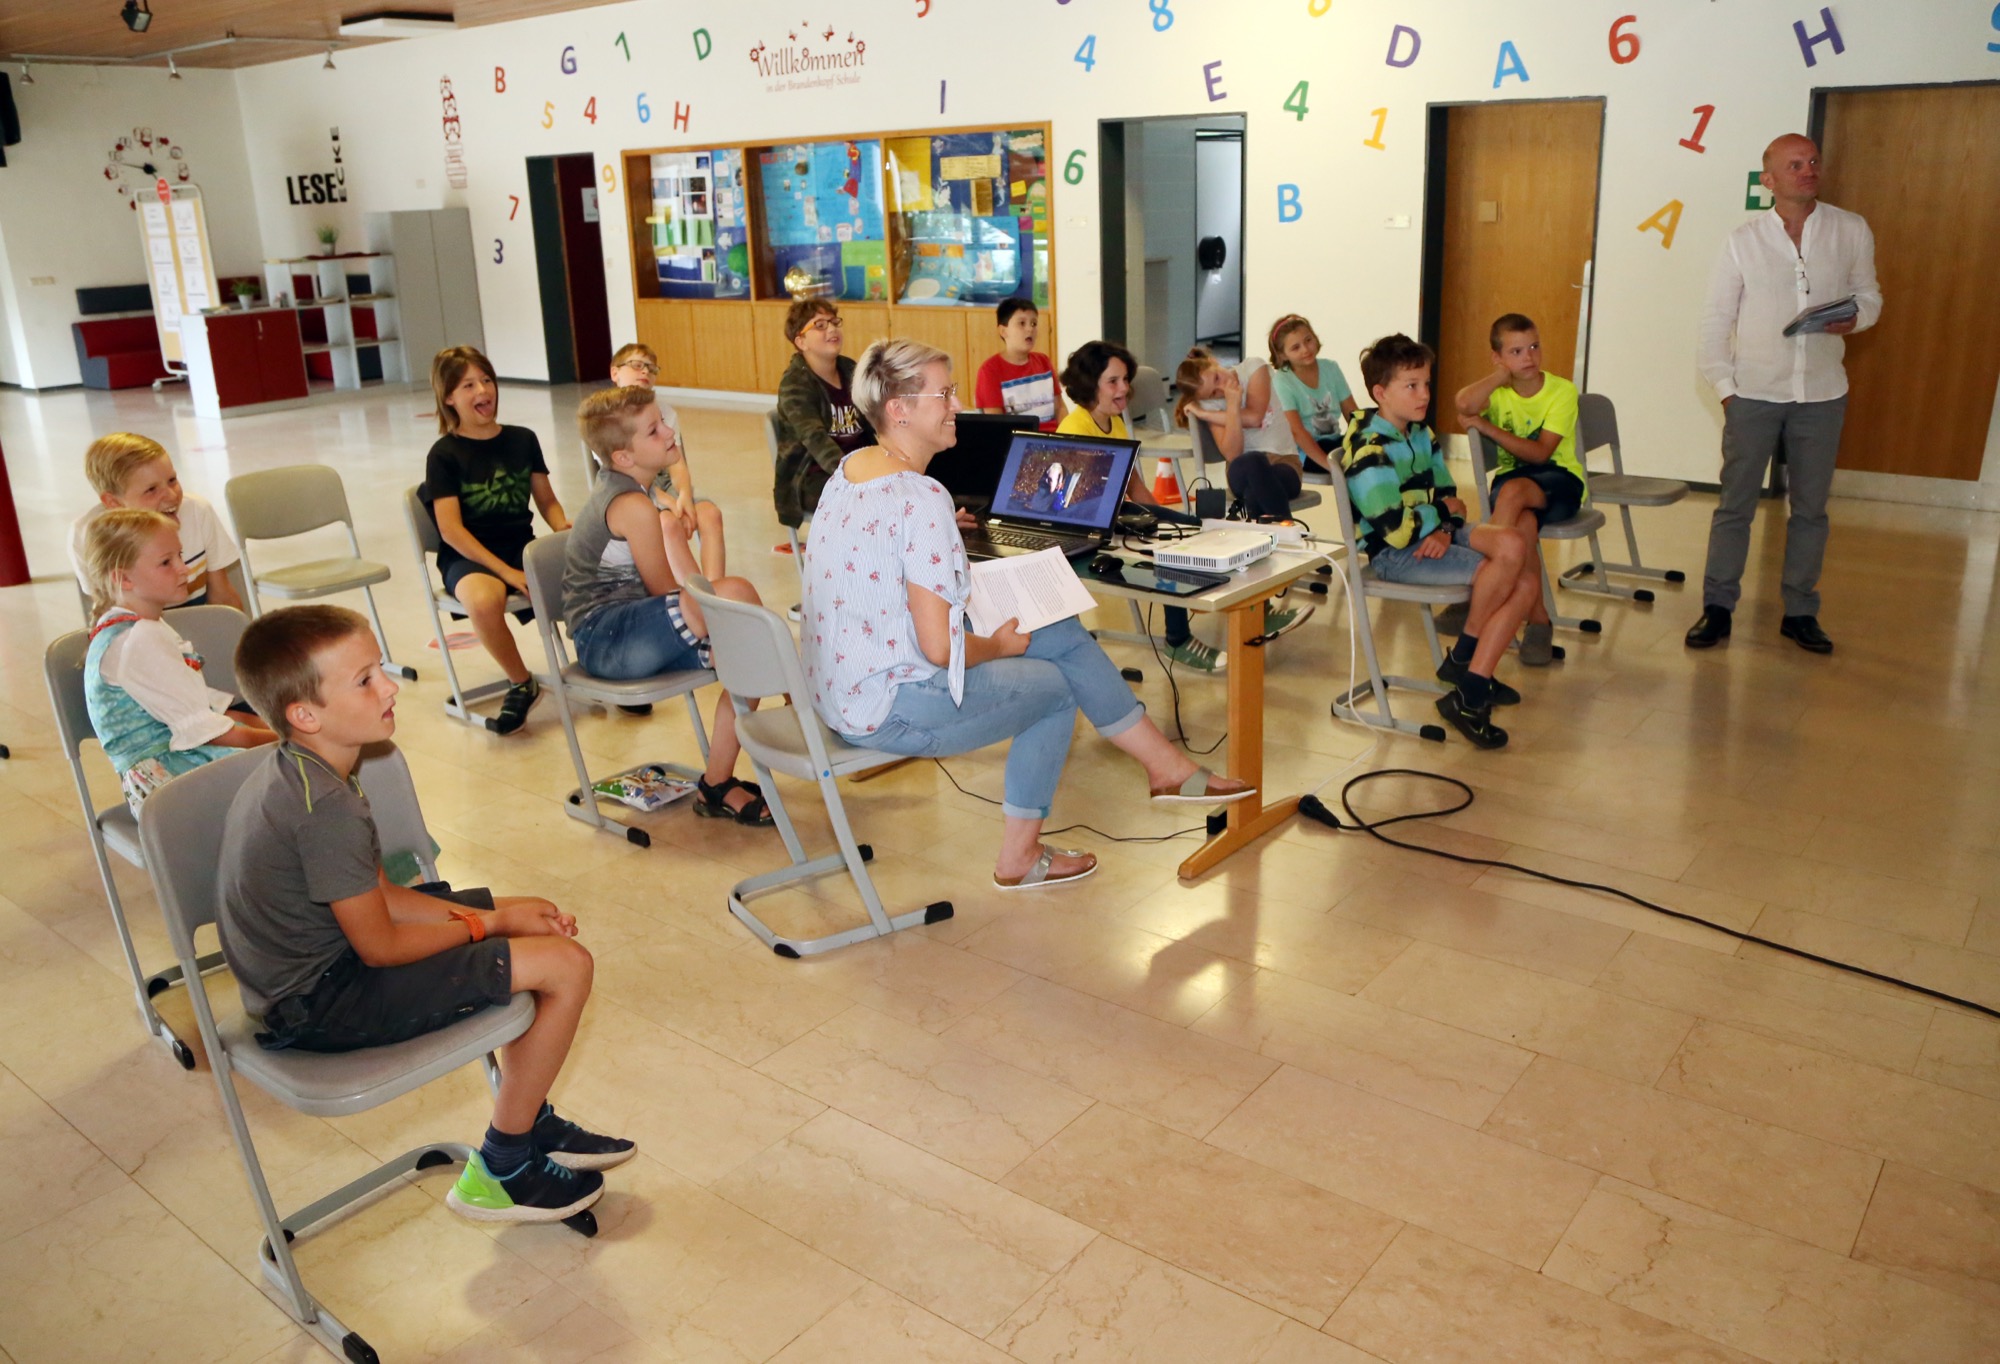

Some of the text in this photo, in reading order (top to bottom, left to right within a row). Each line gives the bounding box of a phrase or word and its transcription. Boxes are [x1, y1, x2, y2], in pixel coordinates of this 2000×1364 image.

[1149, 0, 1174, 32] 8
[692, 27, 712, 61] D
[1073, 34, 1096, 72] 4
[1386, 24, 1422, 69] D
[1608, 14, 1641, 65] 6
[1793, 6, 1846, 68] H
[560, 45, 578, 75] G
[753, 41, 865, 77] Willkommen
[1492, 40, 1530, 89] A
[495, 66, 507, 94] B
[1203, 60, 1227, 102] E
[541, 100, 555, 130] 5
[583, 96, 598, 125] 4
[636, 92, 651, 124] 6
[673, 101, 691, 133] H
[1283, 80, 1309, 122] 4
[1363, 107, 1389, 151] 1
[1679, 103, 1716, 154] 1
[601, 163, 616, 193] 9
[1064, 149, 1087, 186] 6
[286, 173, 338, 205] LESE
[1276, 183, 1303, 224] B
[508, 194, 520, 221] 7
[1637, 199, 1684, 250] A
[493, 238, 504, 264] 3
